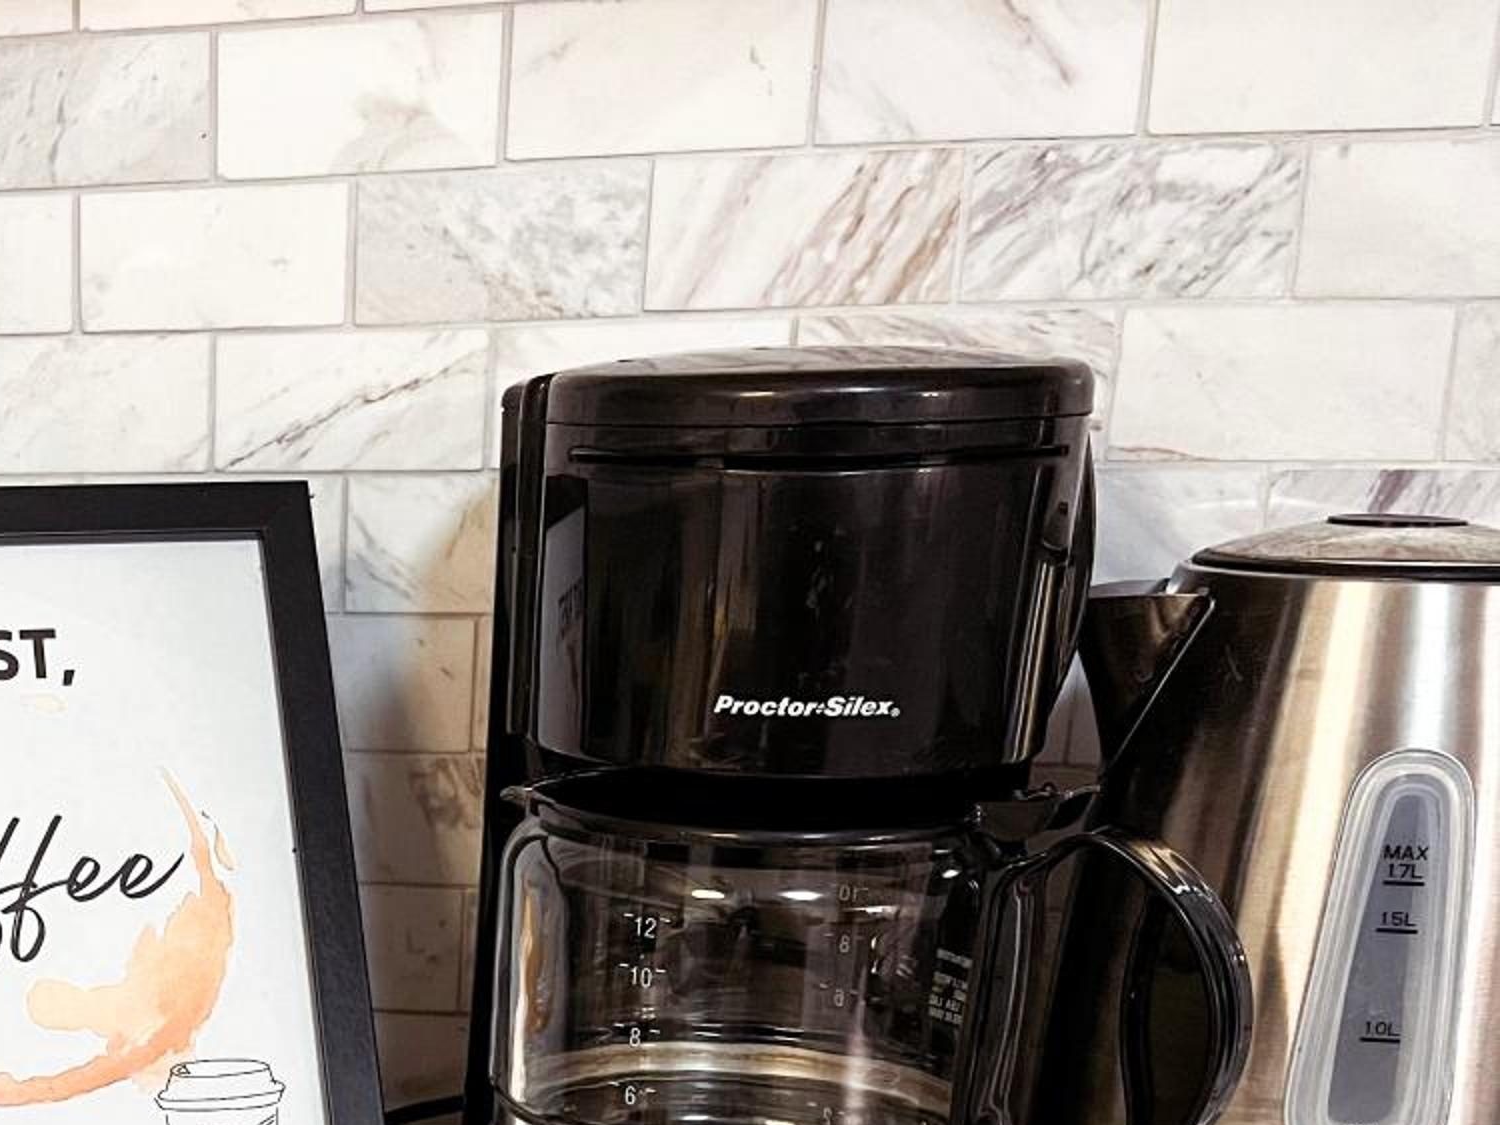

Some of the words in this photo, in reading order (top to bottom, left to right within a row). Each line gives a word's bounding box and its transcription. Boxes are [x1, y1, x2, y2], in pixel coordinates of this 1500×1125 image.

[1383, 844, 1429, 861] MAX
[634, 916, 657, 938] 12
[629, 966, 653, 988] 10
[628, 1027, 641, 1047] 8
[624, 1085, 637, 1105] 6
